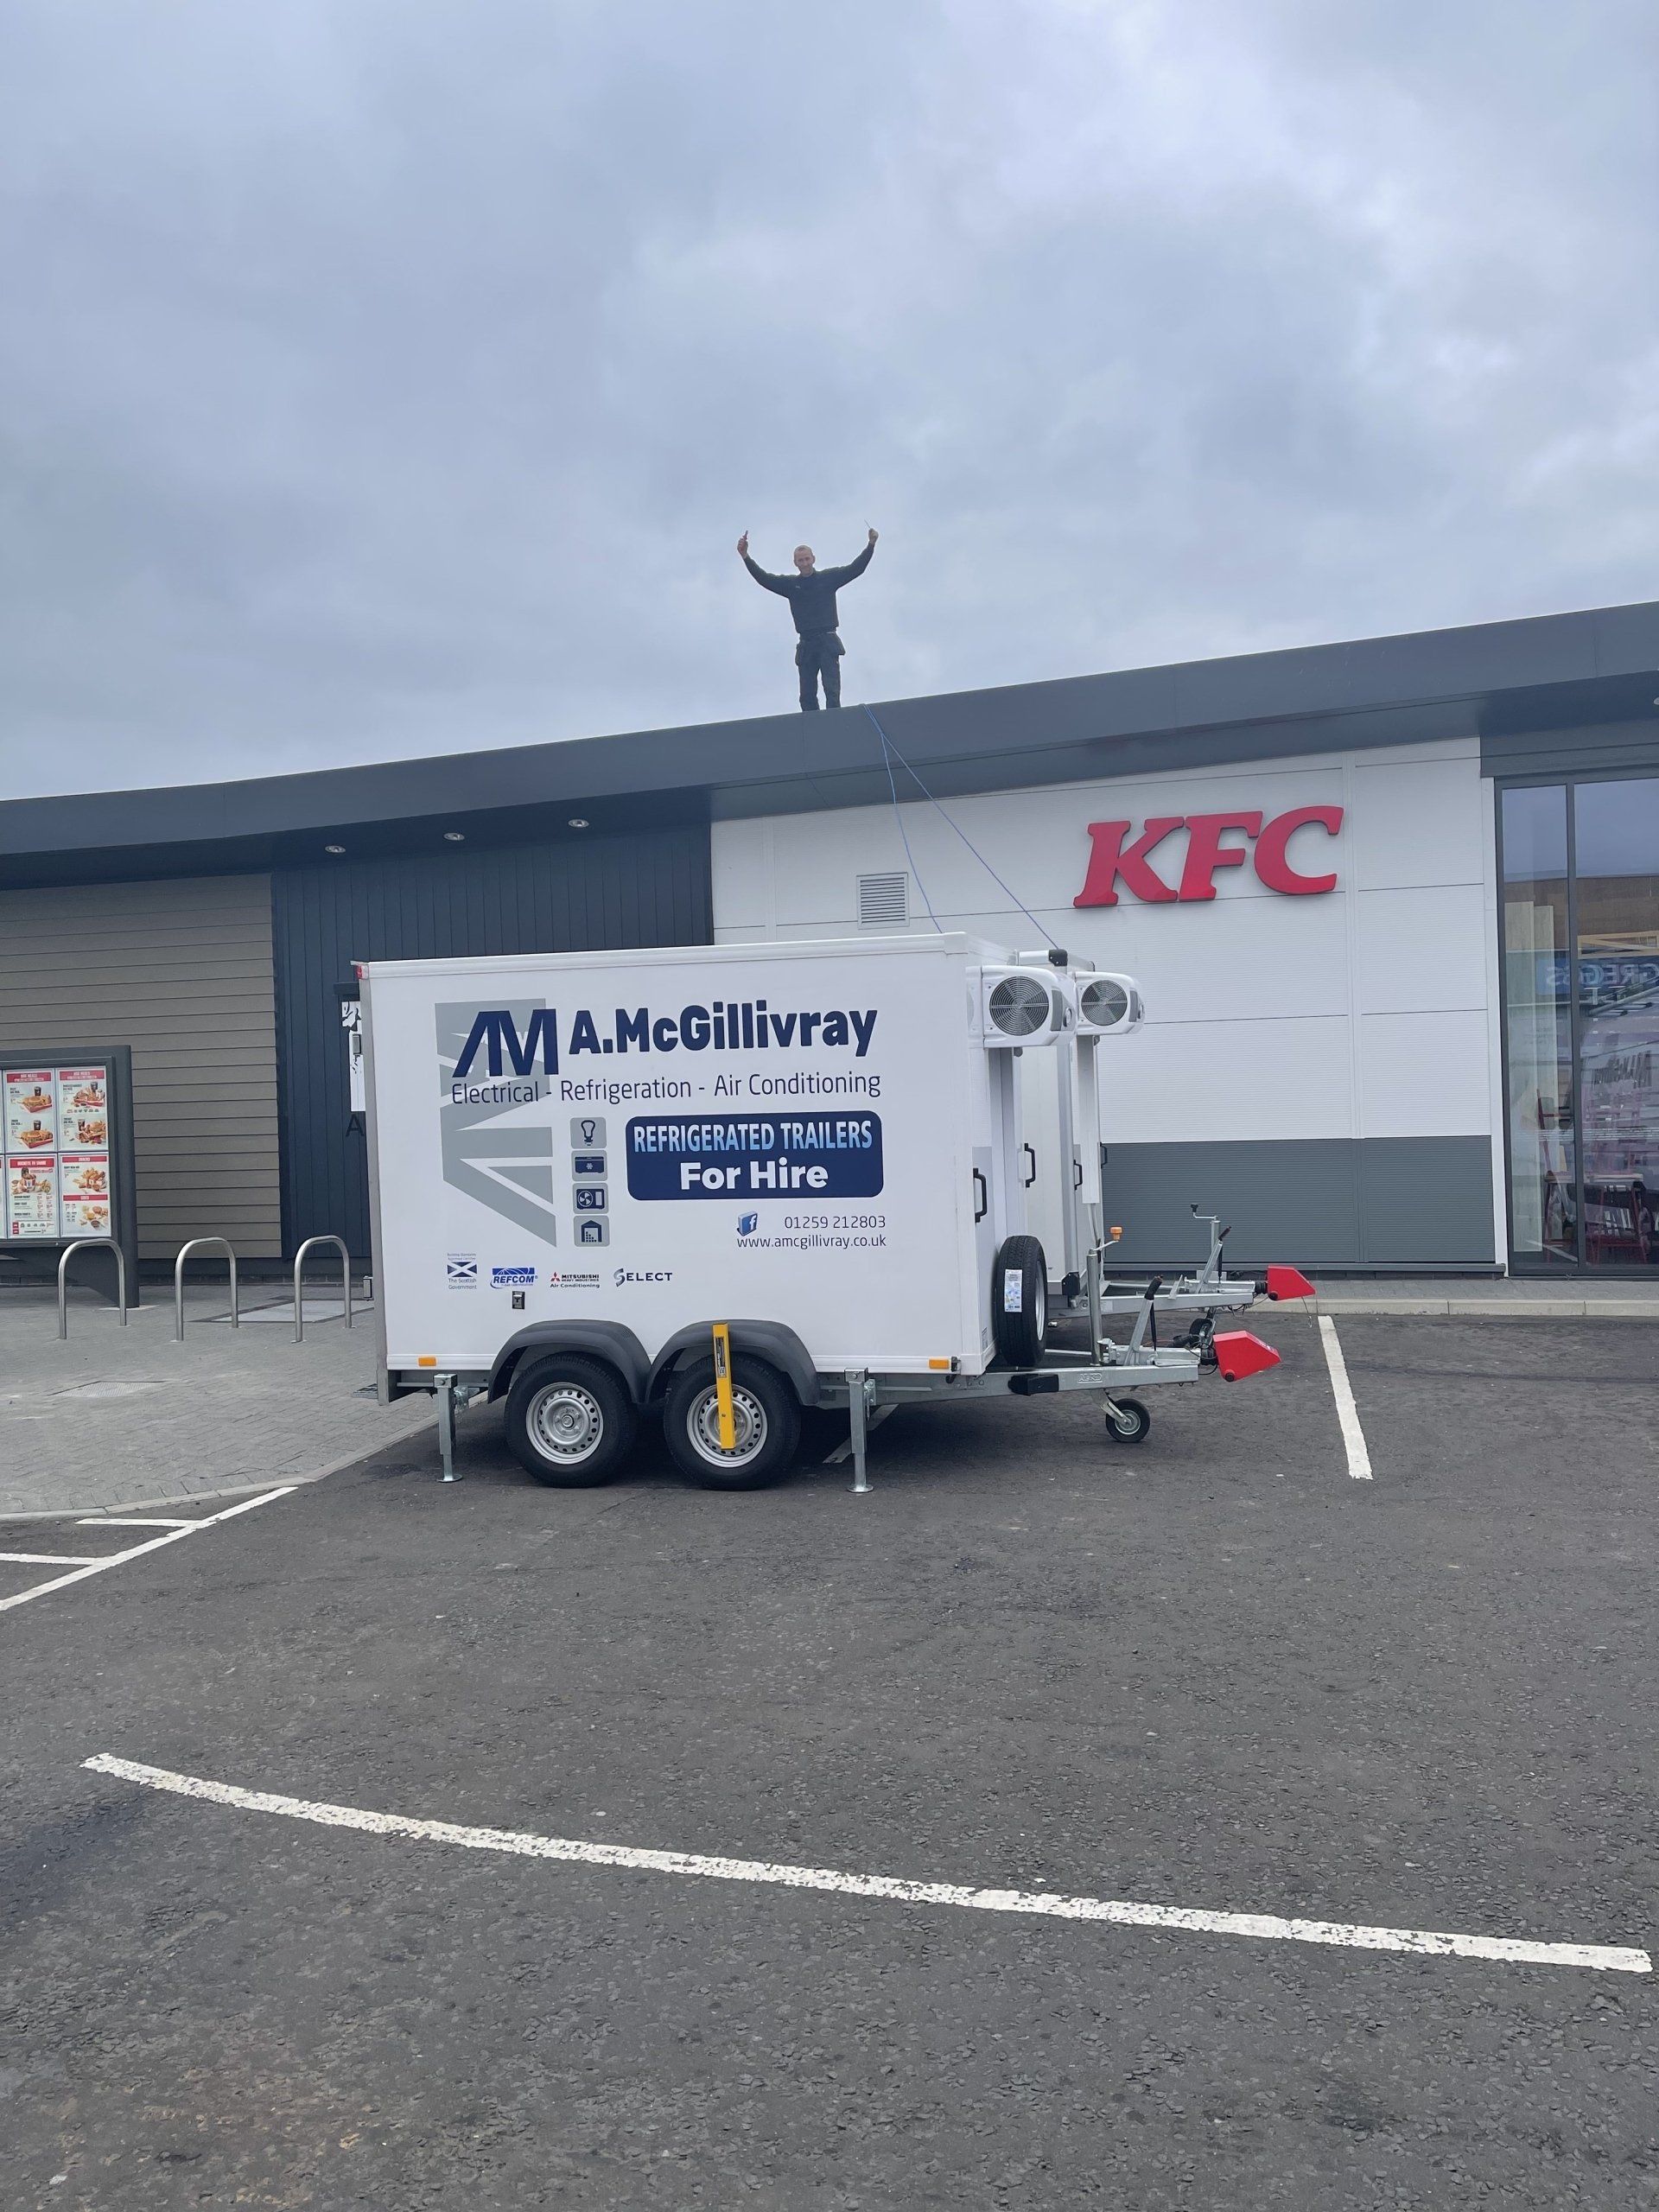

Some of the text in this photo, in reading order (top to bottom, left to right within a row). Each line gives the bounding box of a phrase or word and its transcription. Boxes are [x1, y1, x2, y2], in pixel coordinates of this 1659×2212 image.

[1073, 805, 1344, 907] KFC
[452, 1008, 559, 1077] AM
[569, 1000, 878, 1057] A.McGillivray
[452, 1081, 539, 1104] Electrical
[561, 1077, 692, 1105] Refrigeration
[715, 1075, 742, 1096] Air
[749, 1071, 881, 1098] Conditioning
[633, 1120, 873, 1153] REFRIGERATED TRAILERS
[680, 1156, 829, 1190] For Hire
[785, 1216, 886, 1229] 01259 212803
[737, 1235, 887, 1249] www.amcgillivray.co.uk
[613, 1268, 672, 1287] SELECT
